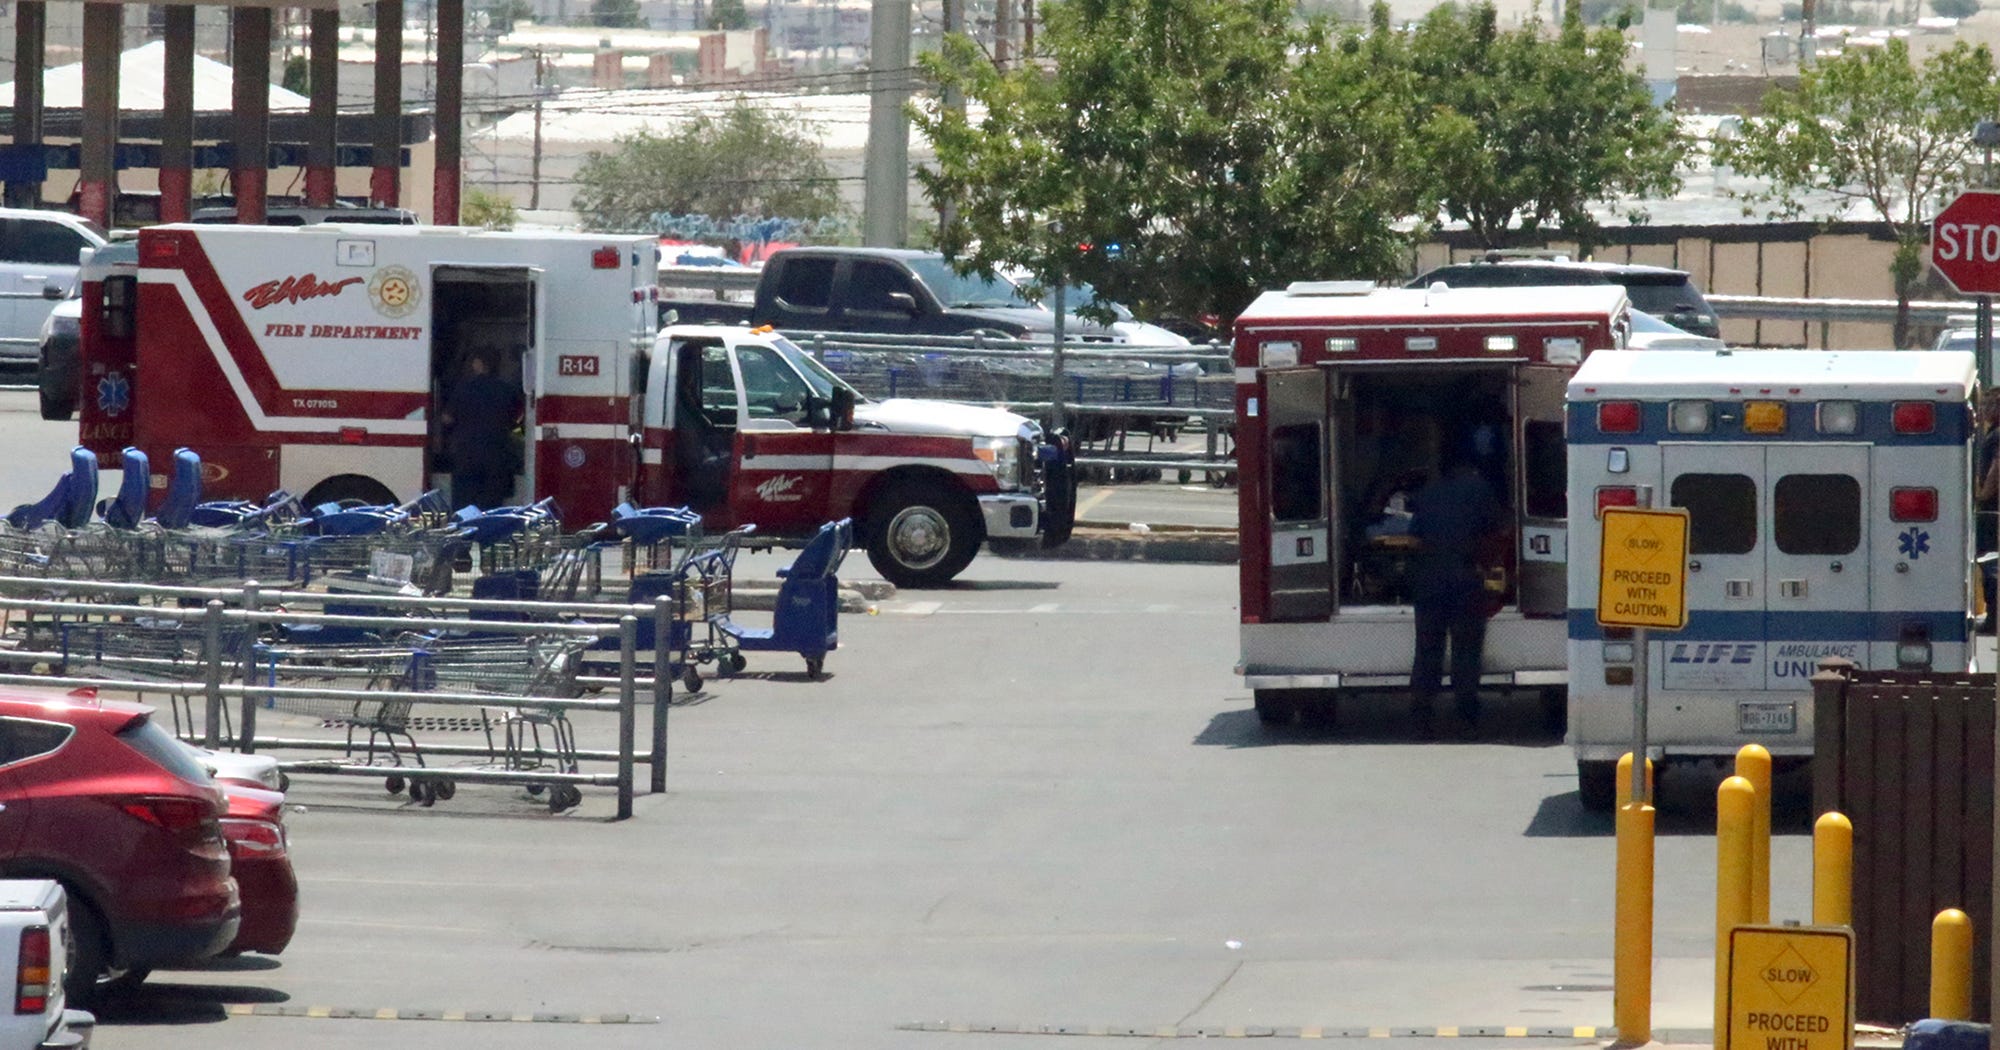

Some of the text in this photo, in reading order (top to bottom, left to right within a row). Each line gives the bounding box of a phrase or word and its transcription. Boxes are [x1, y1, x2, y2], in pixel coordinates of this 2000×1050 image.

[264, 324, 422, 340] FIRE DEPARTMENT
[562, 359, 595, 373] R-14
[292, 398, 306, 408] TX
[1628, 538, 1659, 550] SLOW
[1613, 569, 1671, 585] PROCEED
[1627, 587, 1657, 601] WITH
[1614, 602, 1667, 617] CAUTION
[1669, 644, 1757, 664] LIFE
[1776, 644, 1858, 659] AMBULANCE
[1767, 968, 1812, 983] SLOW
[1748, 1012, 1830, 1033] PROCEED
[1766, 1036, 1809, 1050] WITH
